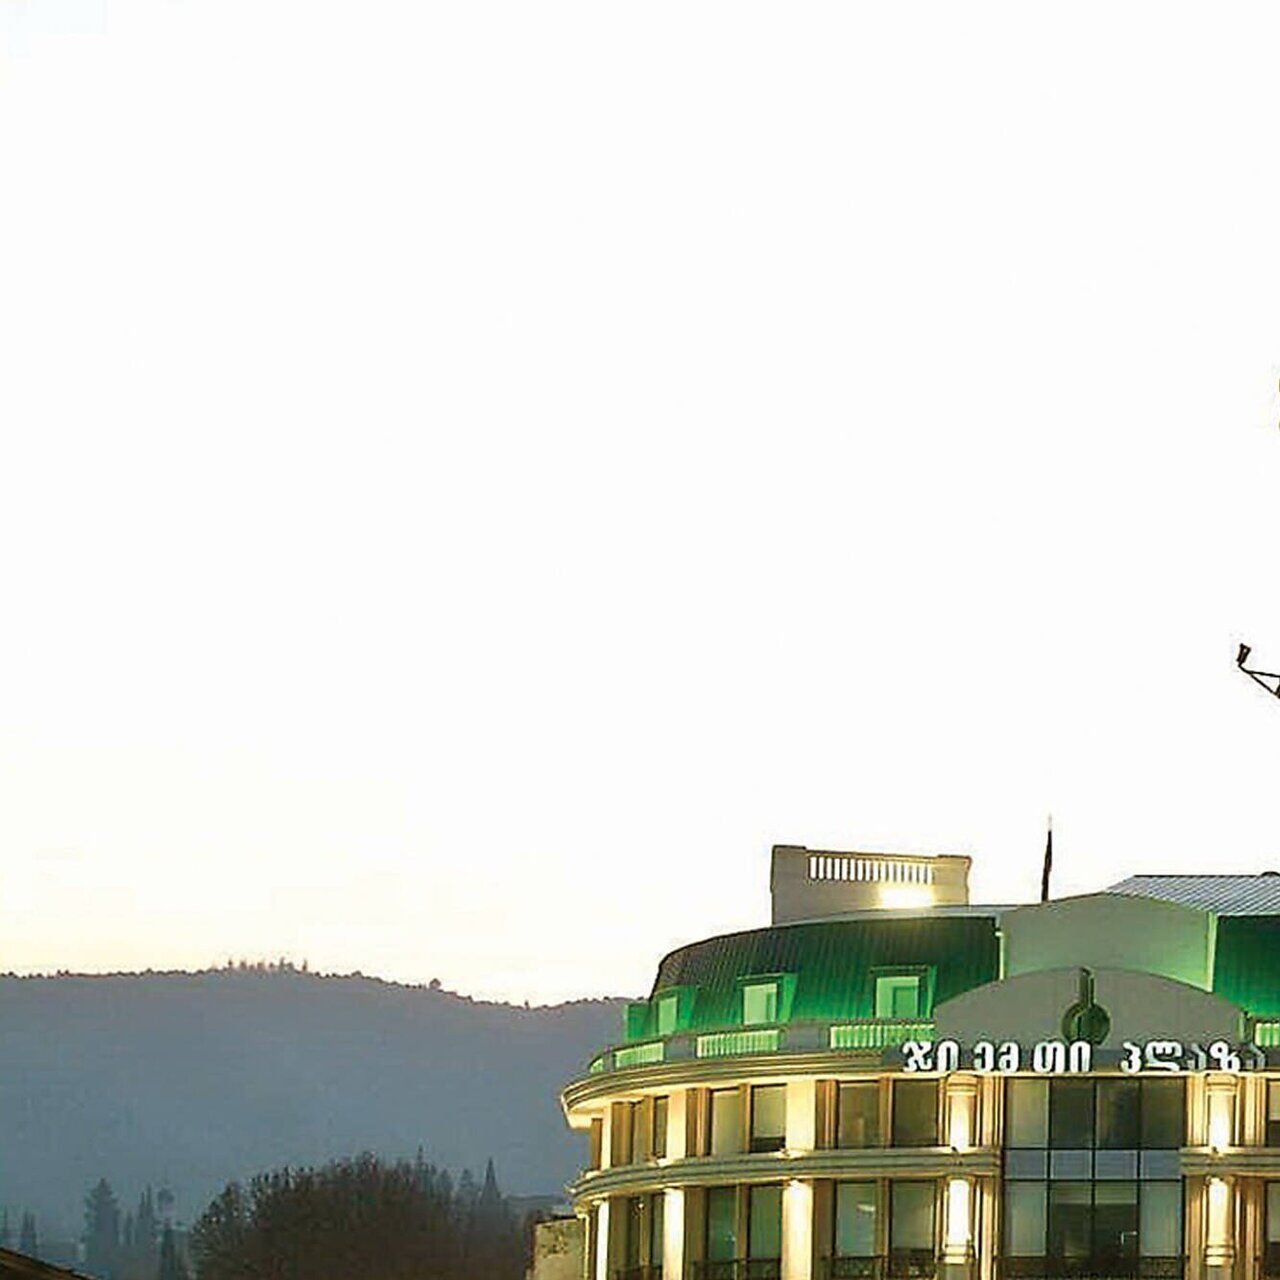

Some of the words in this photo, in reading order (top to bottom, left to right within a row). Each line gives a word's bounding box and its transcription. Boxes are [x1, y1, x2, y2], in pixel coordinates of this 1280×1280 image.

[902, 1040, 960, 1073] ჯი
[973, 1040, 1020, 1073] ემ
[1033, 1040, 1092, 1073] თი
[1120, 1040, 1267, 1073] პლაზა
